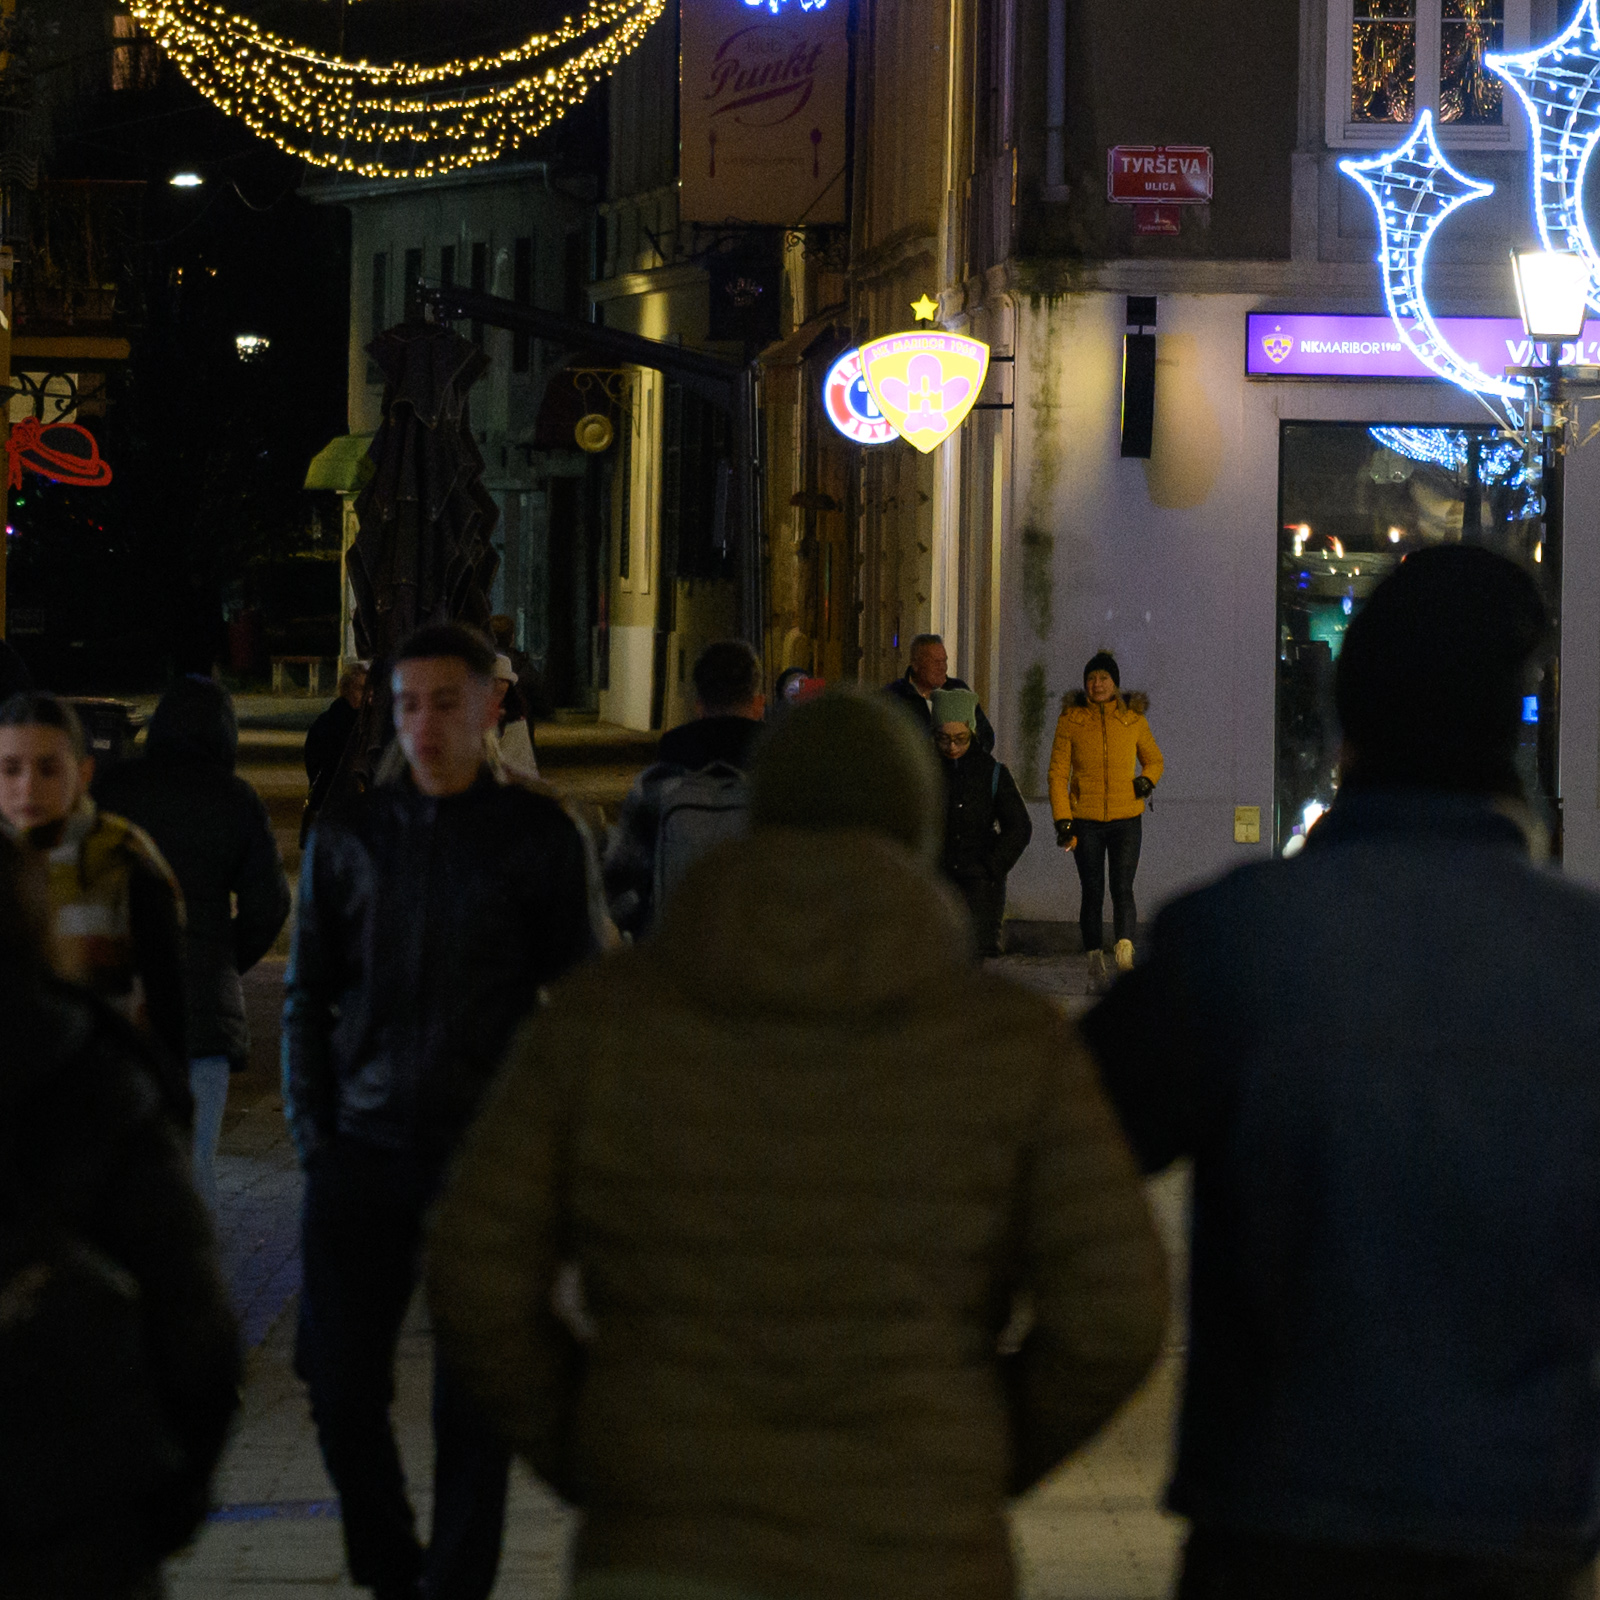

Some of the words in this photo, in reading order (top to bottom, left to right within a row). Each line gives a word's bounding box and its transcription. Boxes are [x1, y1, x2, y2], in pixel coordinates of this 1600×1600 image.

[703, 40, 824, 101] Punkt
[1120, 154, 1201, 175] TYRŠEVA
[1144, 182, 1176, 191] ULICA
[893, 338, 946, 351] MARIBOR
